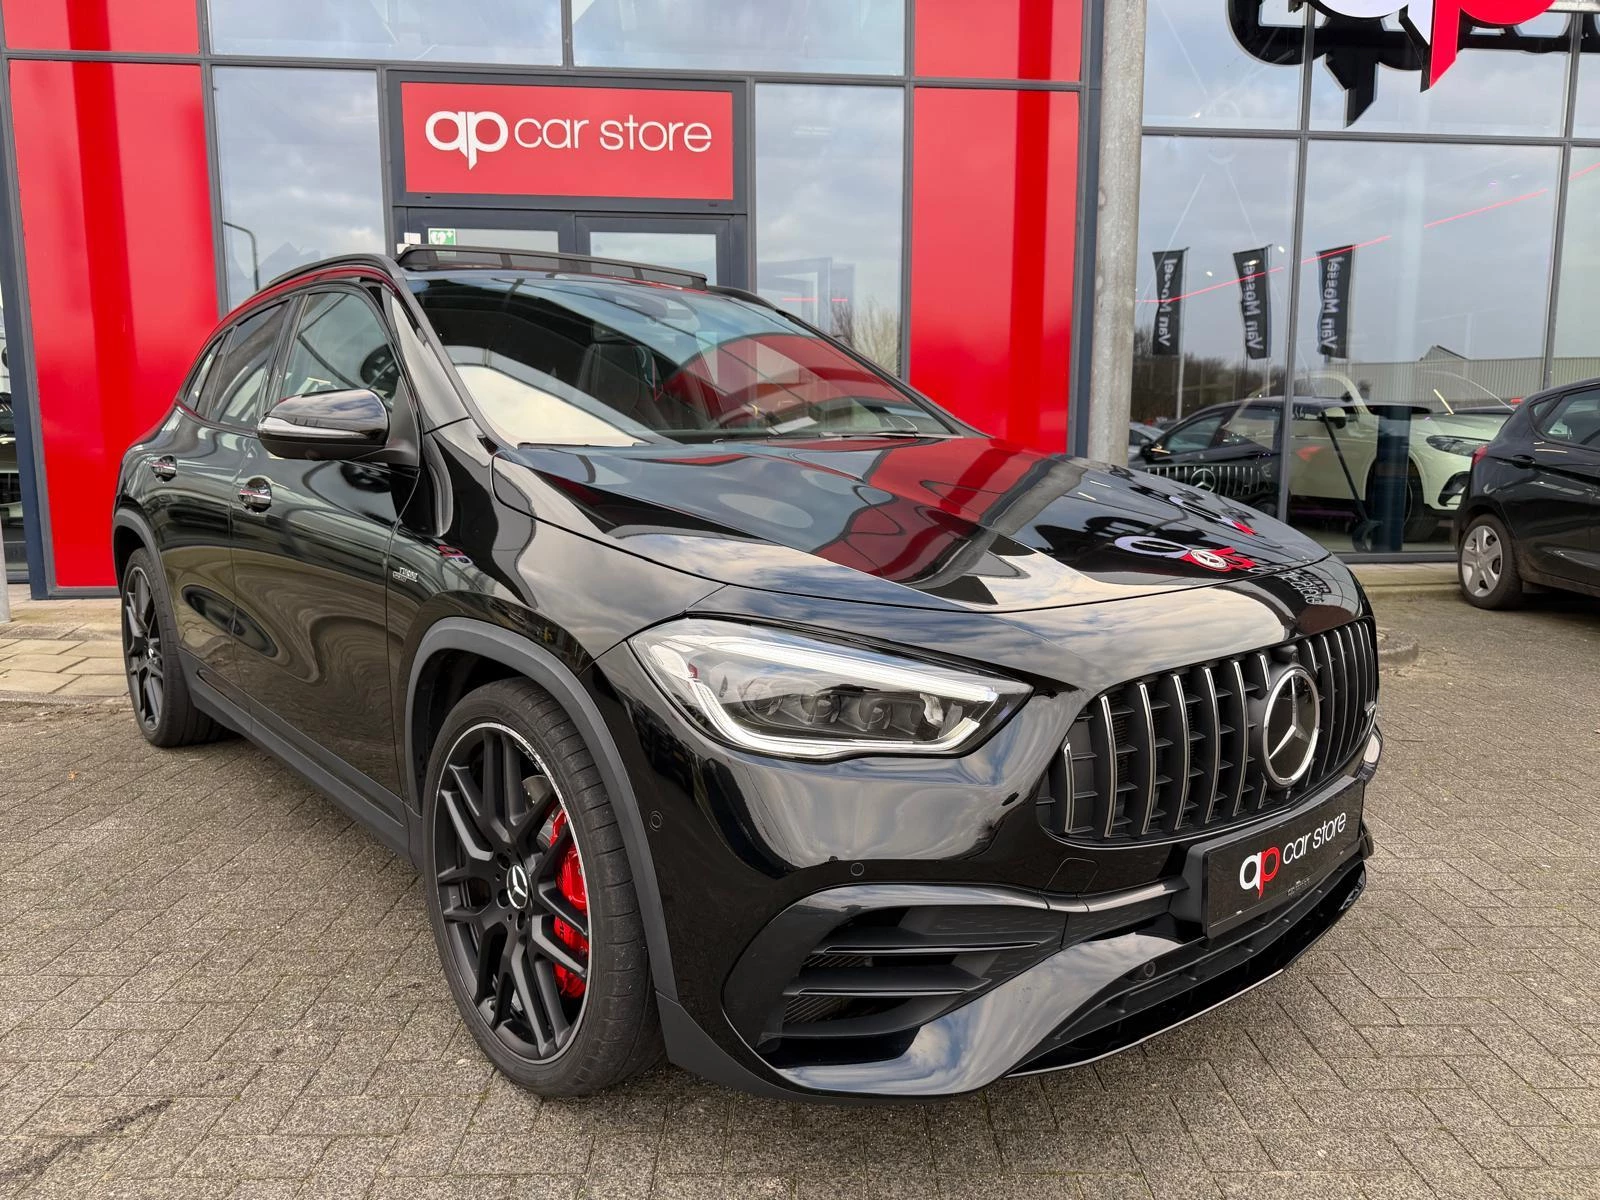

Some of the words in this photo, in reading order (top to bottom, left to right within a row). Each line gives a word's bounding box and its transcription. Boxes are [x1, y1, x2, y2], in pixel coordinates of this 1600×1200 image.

[514, 118, 589, 149] car
[599, 114, 712, 153] store
[1282, 832, 1312, 865] car
[1312, 812, 1347, 849] store
